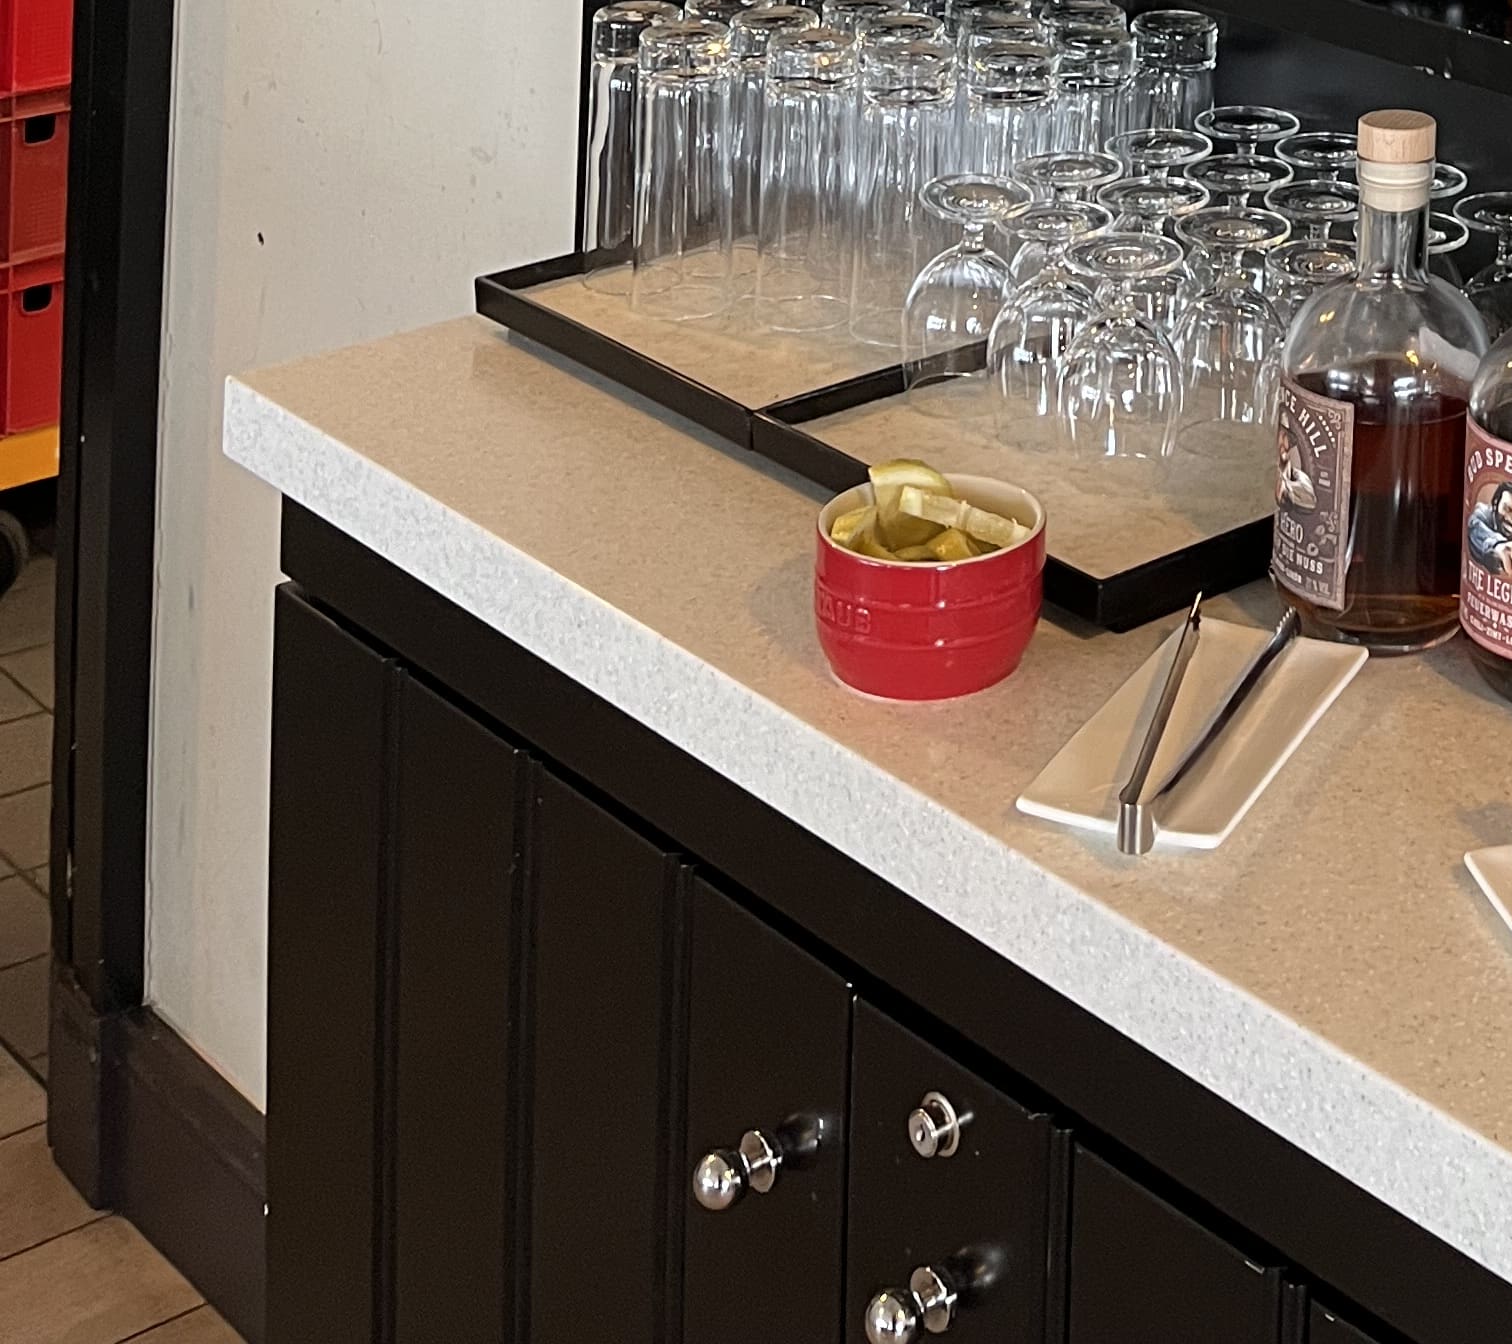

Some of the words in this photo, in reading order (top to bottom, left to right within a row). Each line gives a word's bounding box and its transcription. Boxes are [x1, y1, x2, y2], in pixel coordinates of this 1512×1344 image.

[1298, 406, 1328, 459] HILL
[1467, 450, 1484, 484] BUD
[1296, 553, 1324, 576] NUSS
[1467, 560, 1485, 592] THE
